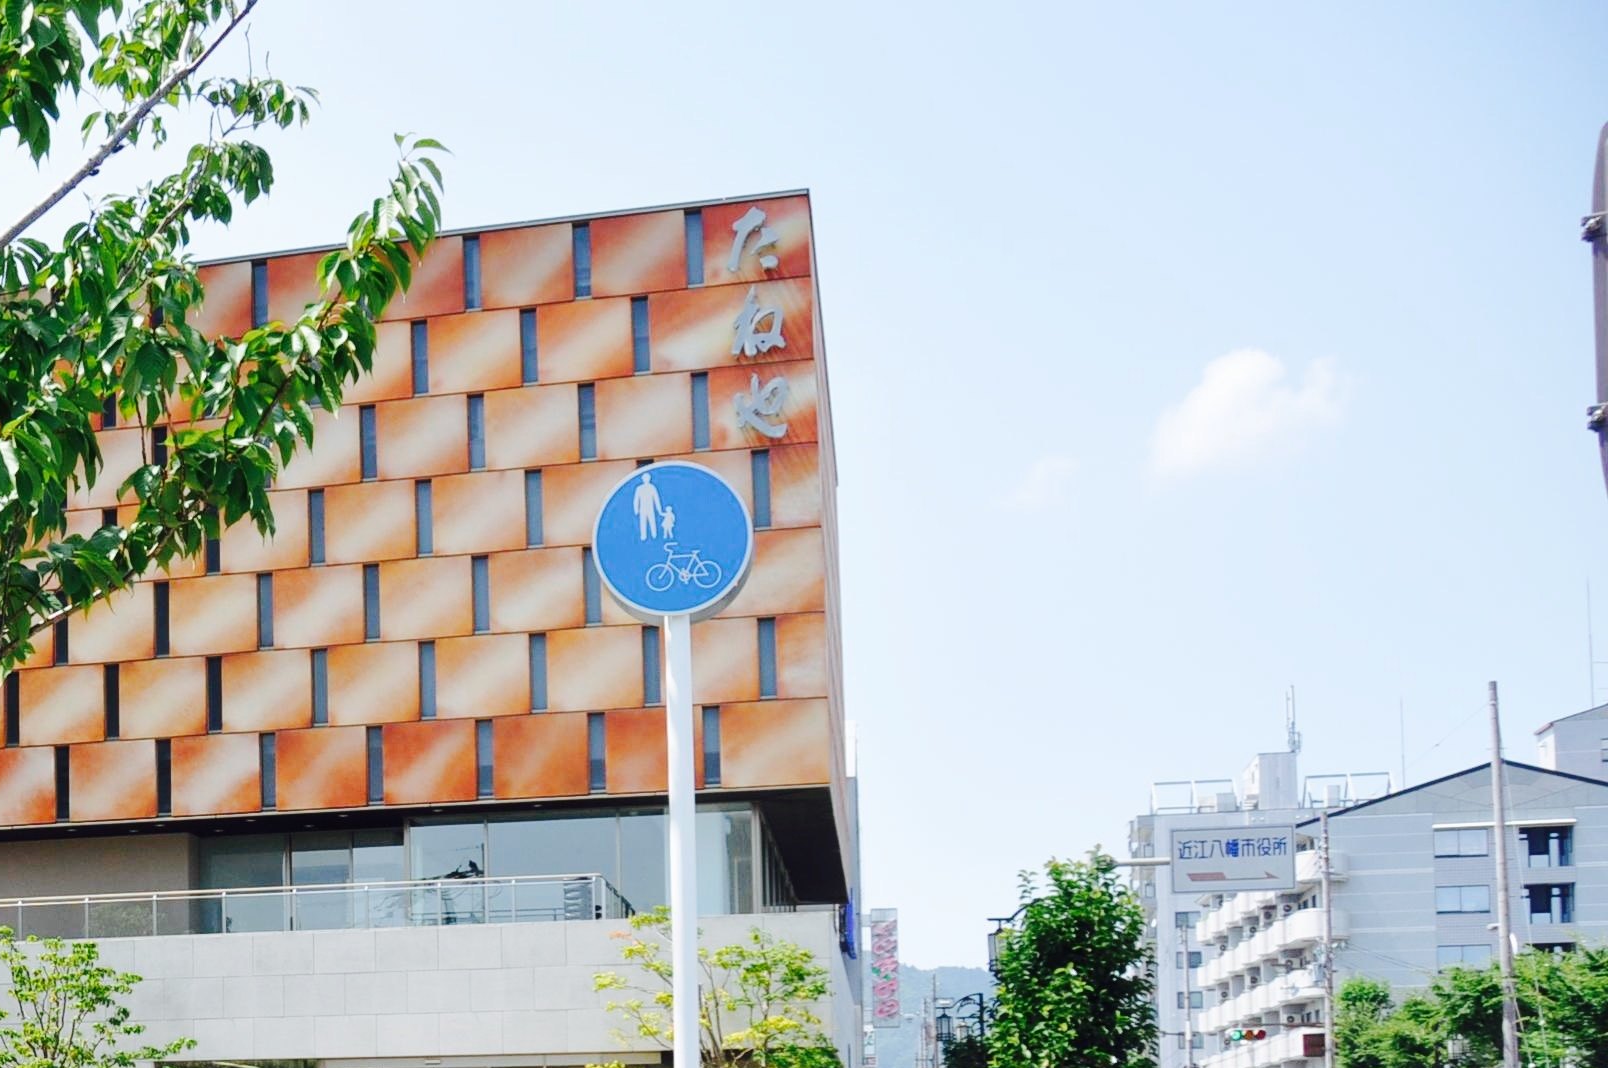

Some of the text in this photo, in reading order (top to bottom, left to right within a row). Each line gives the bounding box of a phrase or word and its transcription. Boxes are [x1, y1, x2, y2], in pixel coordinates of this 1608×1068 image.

[727, 206, 789, 439] たねや
[1178, 837, 1287, 859] 近江八幡市役所
